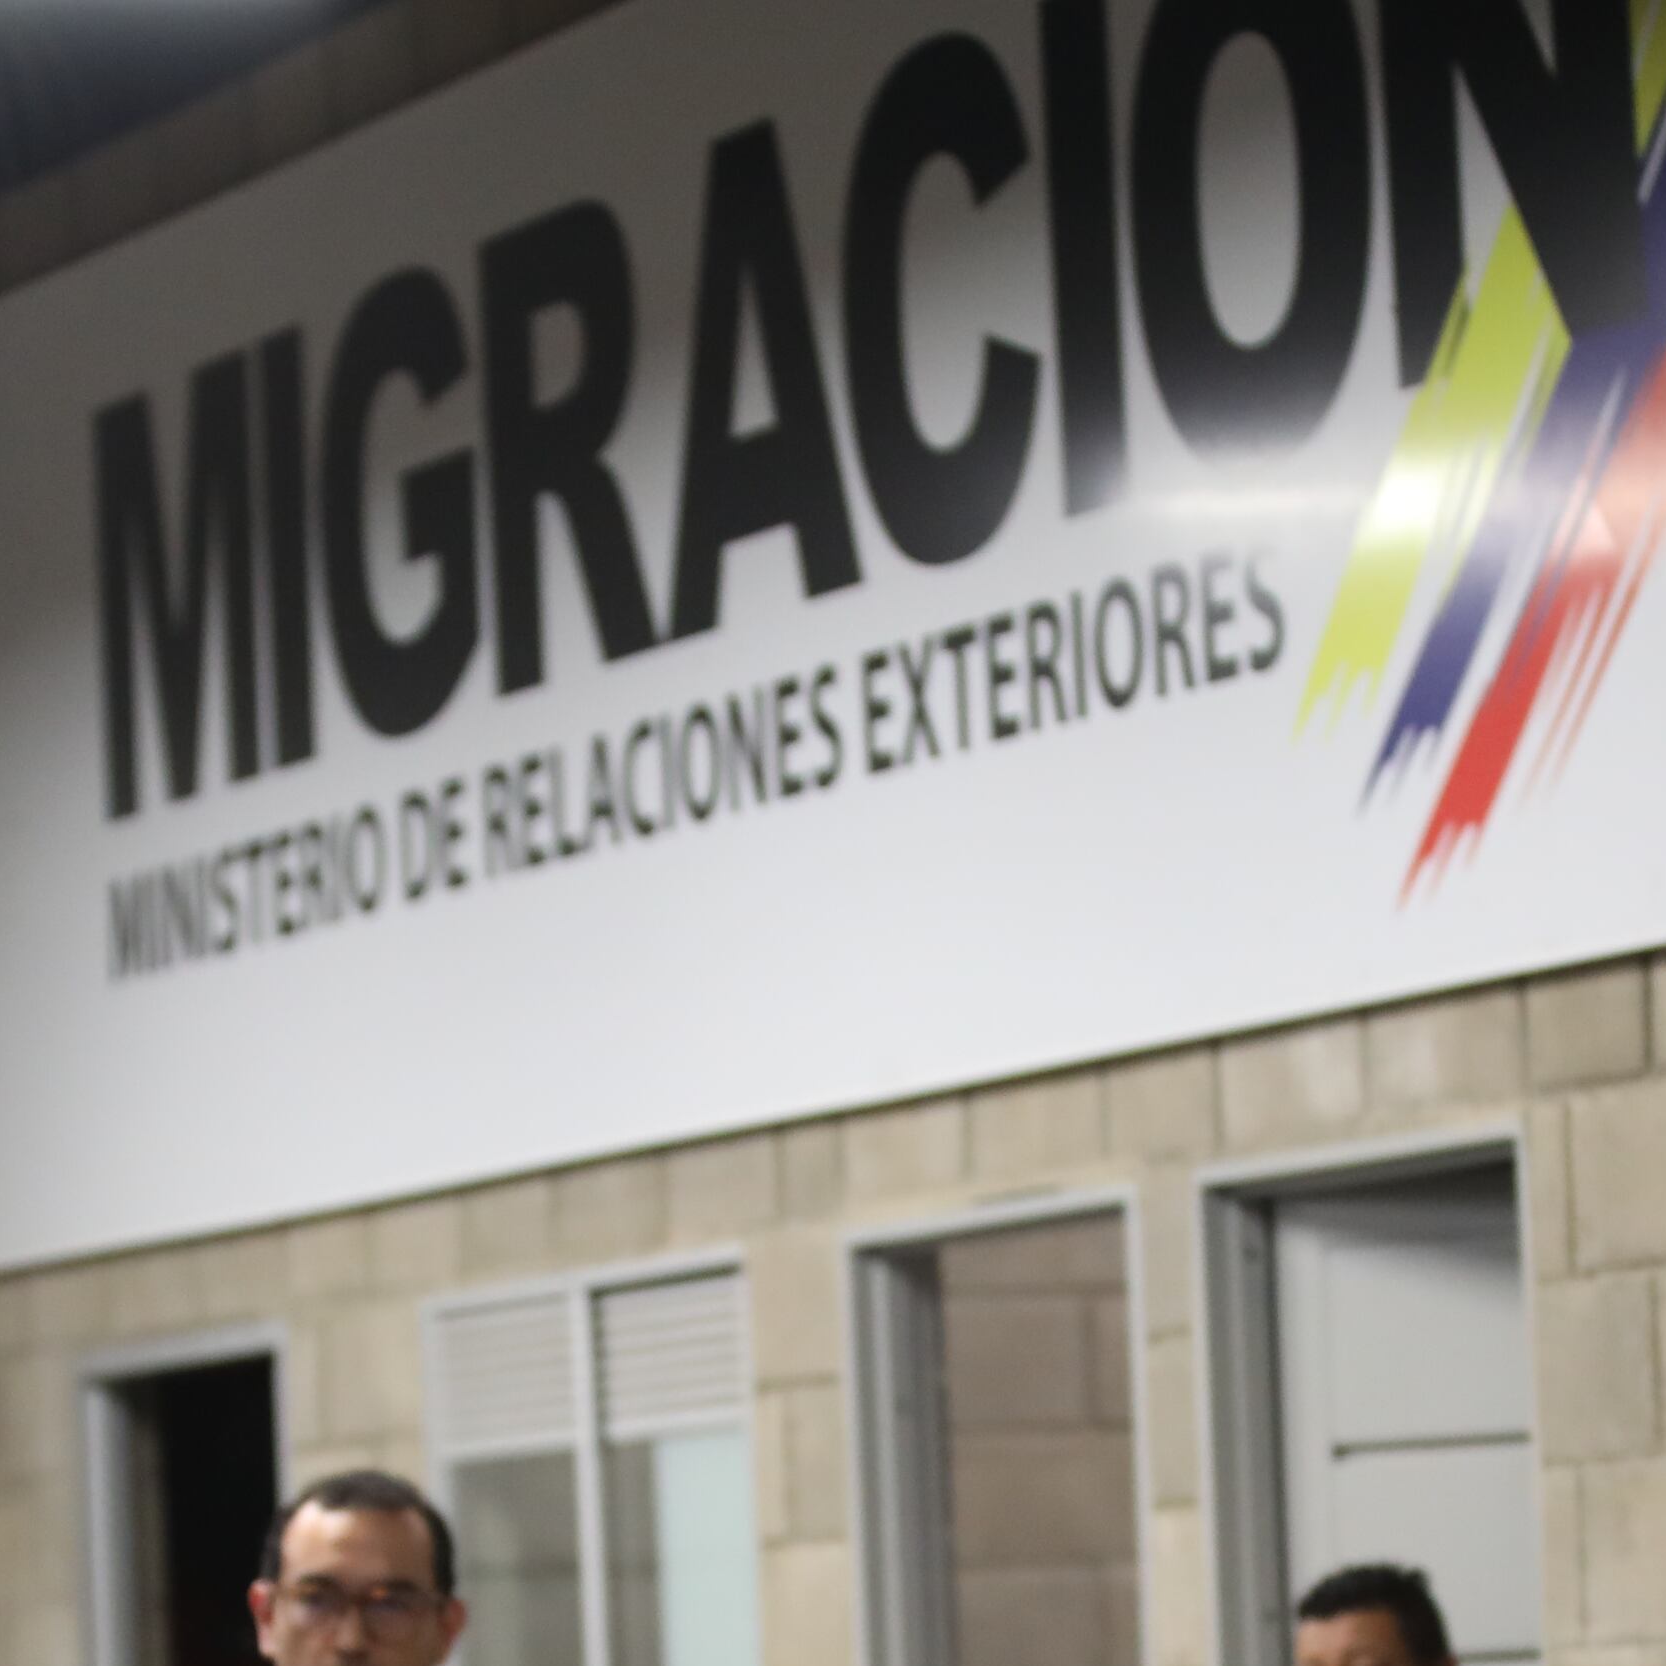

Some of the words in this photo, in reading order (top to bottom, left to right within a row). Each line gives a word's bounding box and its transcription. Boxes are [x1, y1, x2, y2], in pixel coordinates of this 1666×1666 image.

[107, 804, 386, 982] MINISTERIO
[399, 777, 467, 900] DE
[483, 664, 844, 880] RELACIONES
[862, 546, 1287, 776] EXTERIORES
